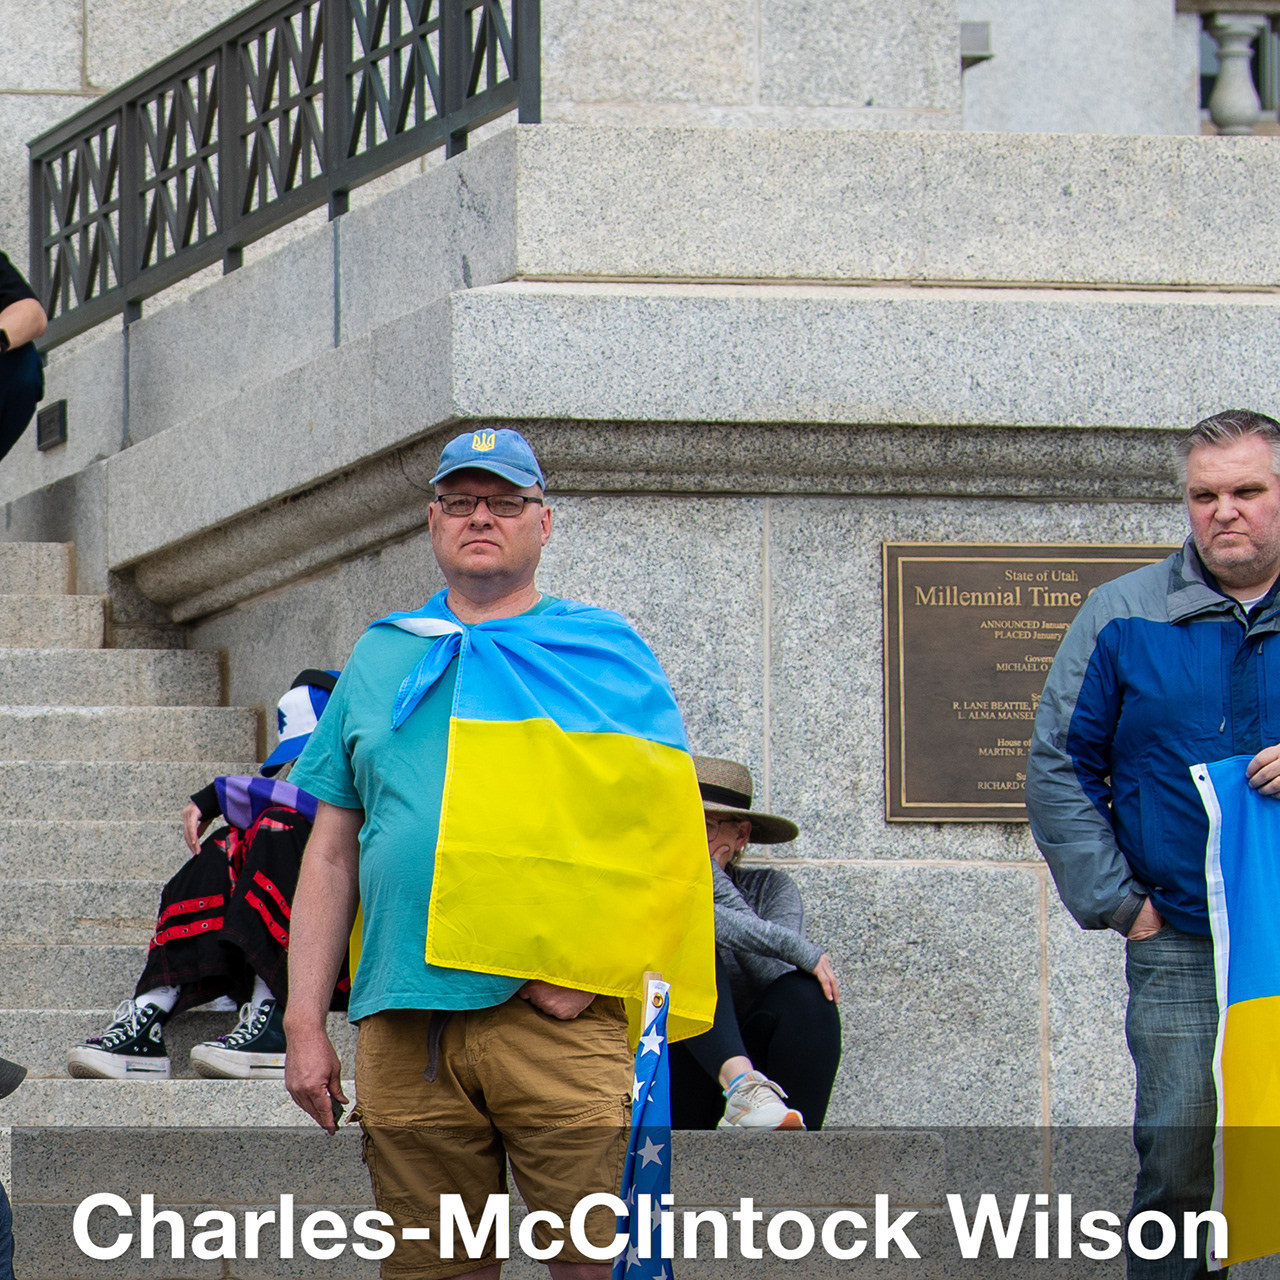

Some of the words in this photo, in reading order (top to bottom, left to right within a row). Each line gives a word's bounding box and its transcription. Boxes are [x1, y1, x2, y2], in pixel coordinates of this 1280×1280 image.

[1005, 569, 1033, 582] State
[1036, 569, 1049, 582] of
[1051, 569, 1079, 582] Utah
[915, 585, 1022, 607] Millennial
[1028, 586, 1082, 607] Time
[980, 620, 1040, 630] ANNOUNCED
[1041, 620, 1070, 632] January
[994, 630, 1032, 640] PLACED
[1033, 631, 1063, 642] January
[1024, 654, 1055, 663] Govern
[996, 662, 1039, 672] MICHAEL
[963, 701, 989, 711] LANE
[990, 701, 1032, 712] BEATTIE,
[968, 711, 996, 720] ALMA
[998, 711, 1036, 721] MANSEL
[997, 738, 1022, 747] House
[978, 747, 1016, 756] MARTIN
[977, 781, 1020, 790] RICHARD
